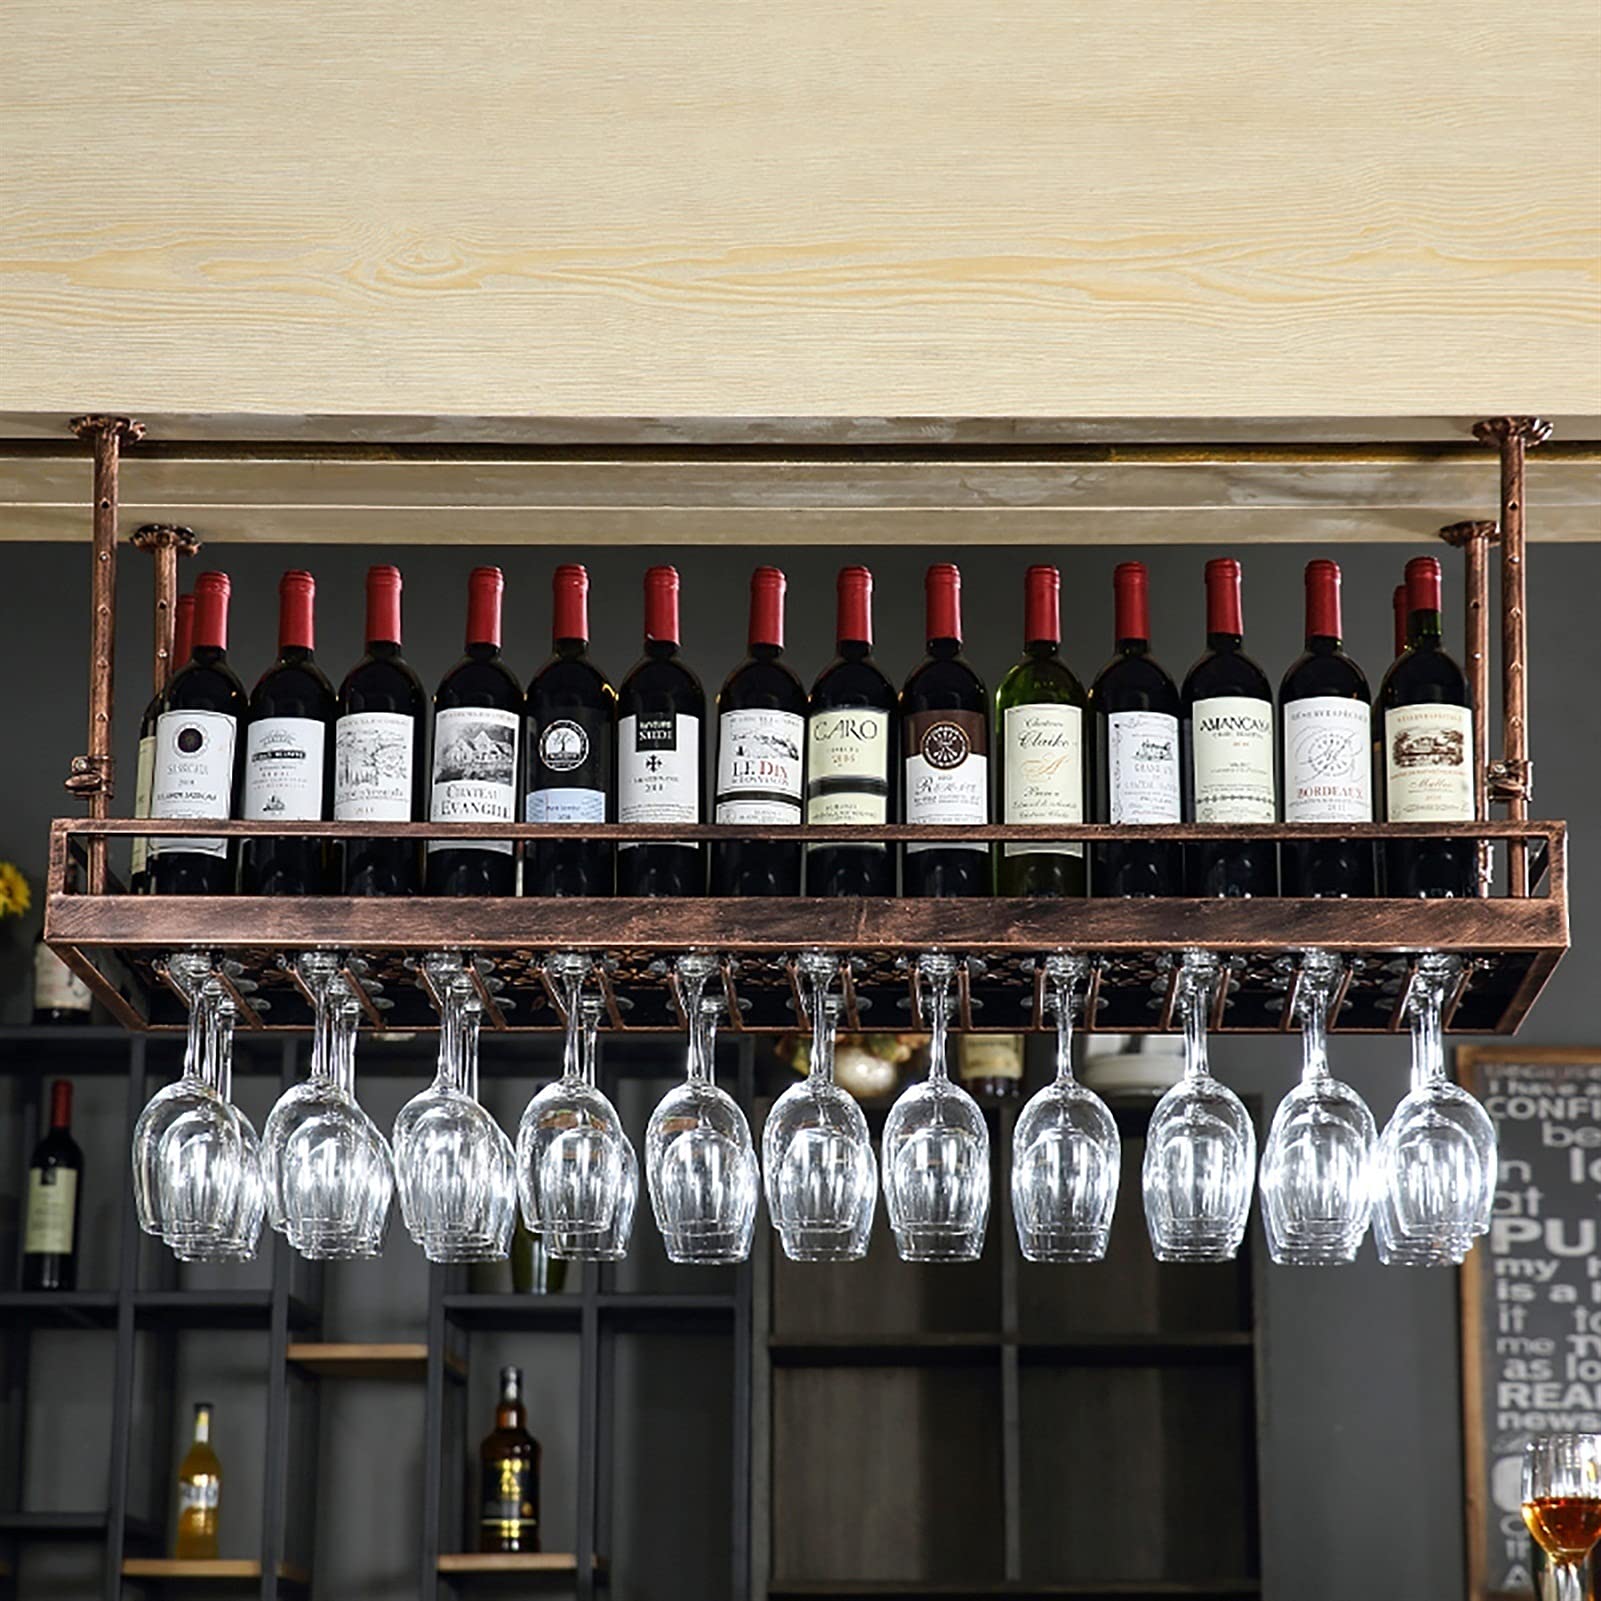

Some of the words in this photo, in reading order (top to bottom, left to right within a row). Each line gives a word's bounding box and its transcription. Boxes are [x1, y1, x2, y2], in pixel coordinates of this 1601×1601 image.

[814, 719, 877, 742] CARO
[1297, 785, 1363, 799] BORDEAUX
[1494, 1258, 1560, 1282] my
[1497, 1278, 1535, 1302] is
[1548, 1284, 1578, 1303] a
[1498, 1303, 1527, 1334] it
[1496, 1336, 1555, 1356] me
[1502, 1357, 1552, 1382] as
